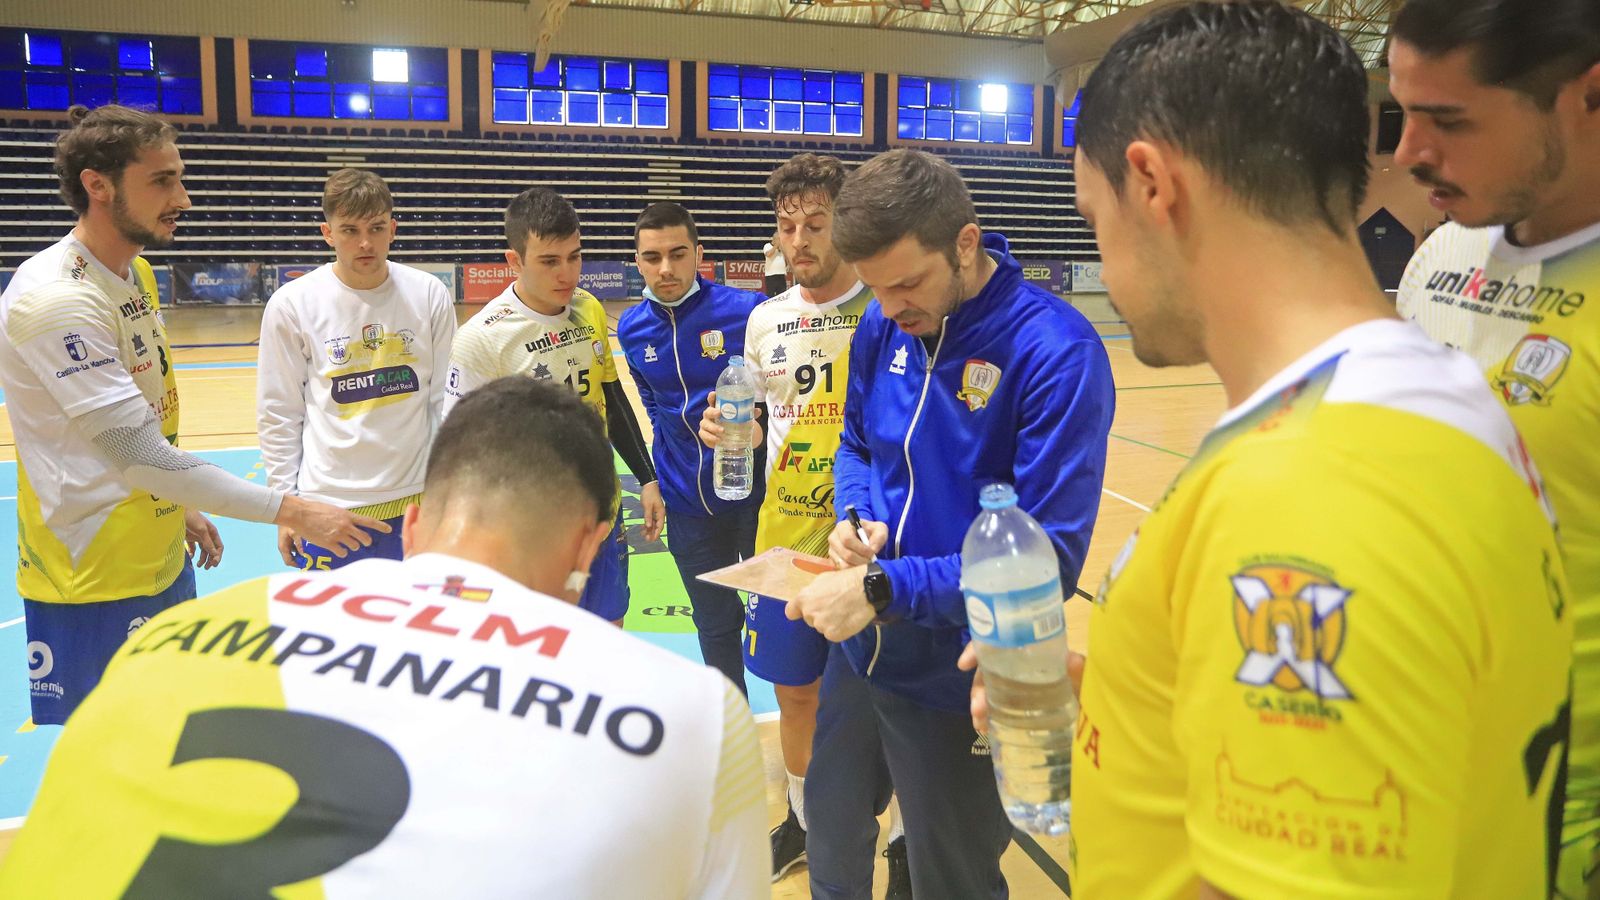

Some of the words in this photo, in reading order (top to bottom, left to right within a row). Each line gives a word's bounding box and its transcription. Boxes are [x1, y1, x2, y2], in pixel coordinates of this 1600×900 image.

[579, 272, 623, 283] populares
[592, 281, 623, 289] Algeciras
[1425, 267, 1585, 317] unikahome
[777, 313, 862, 334] unikahom
[525, 325, 595, 353] unikahome
[766, 368, 786, 378] CLM
[794, 362, 833, 395] 91
[400, 382, 414, 391] Real
[806, 509, 833, 518] nunca
[273, 578, 571, 659] UCLM
[128, 619, 665, 757] CAMPANARIO
[1216, 803, 1319, 850] CIUDAD
[1330, 833, 1407, 861] REAL
